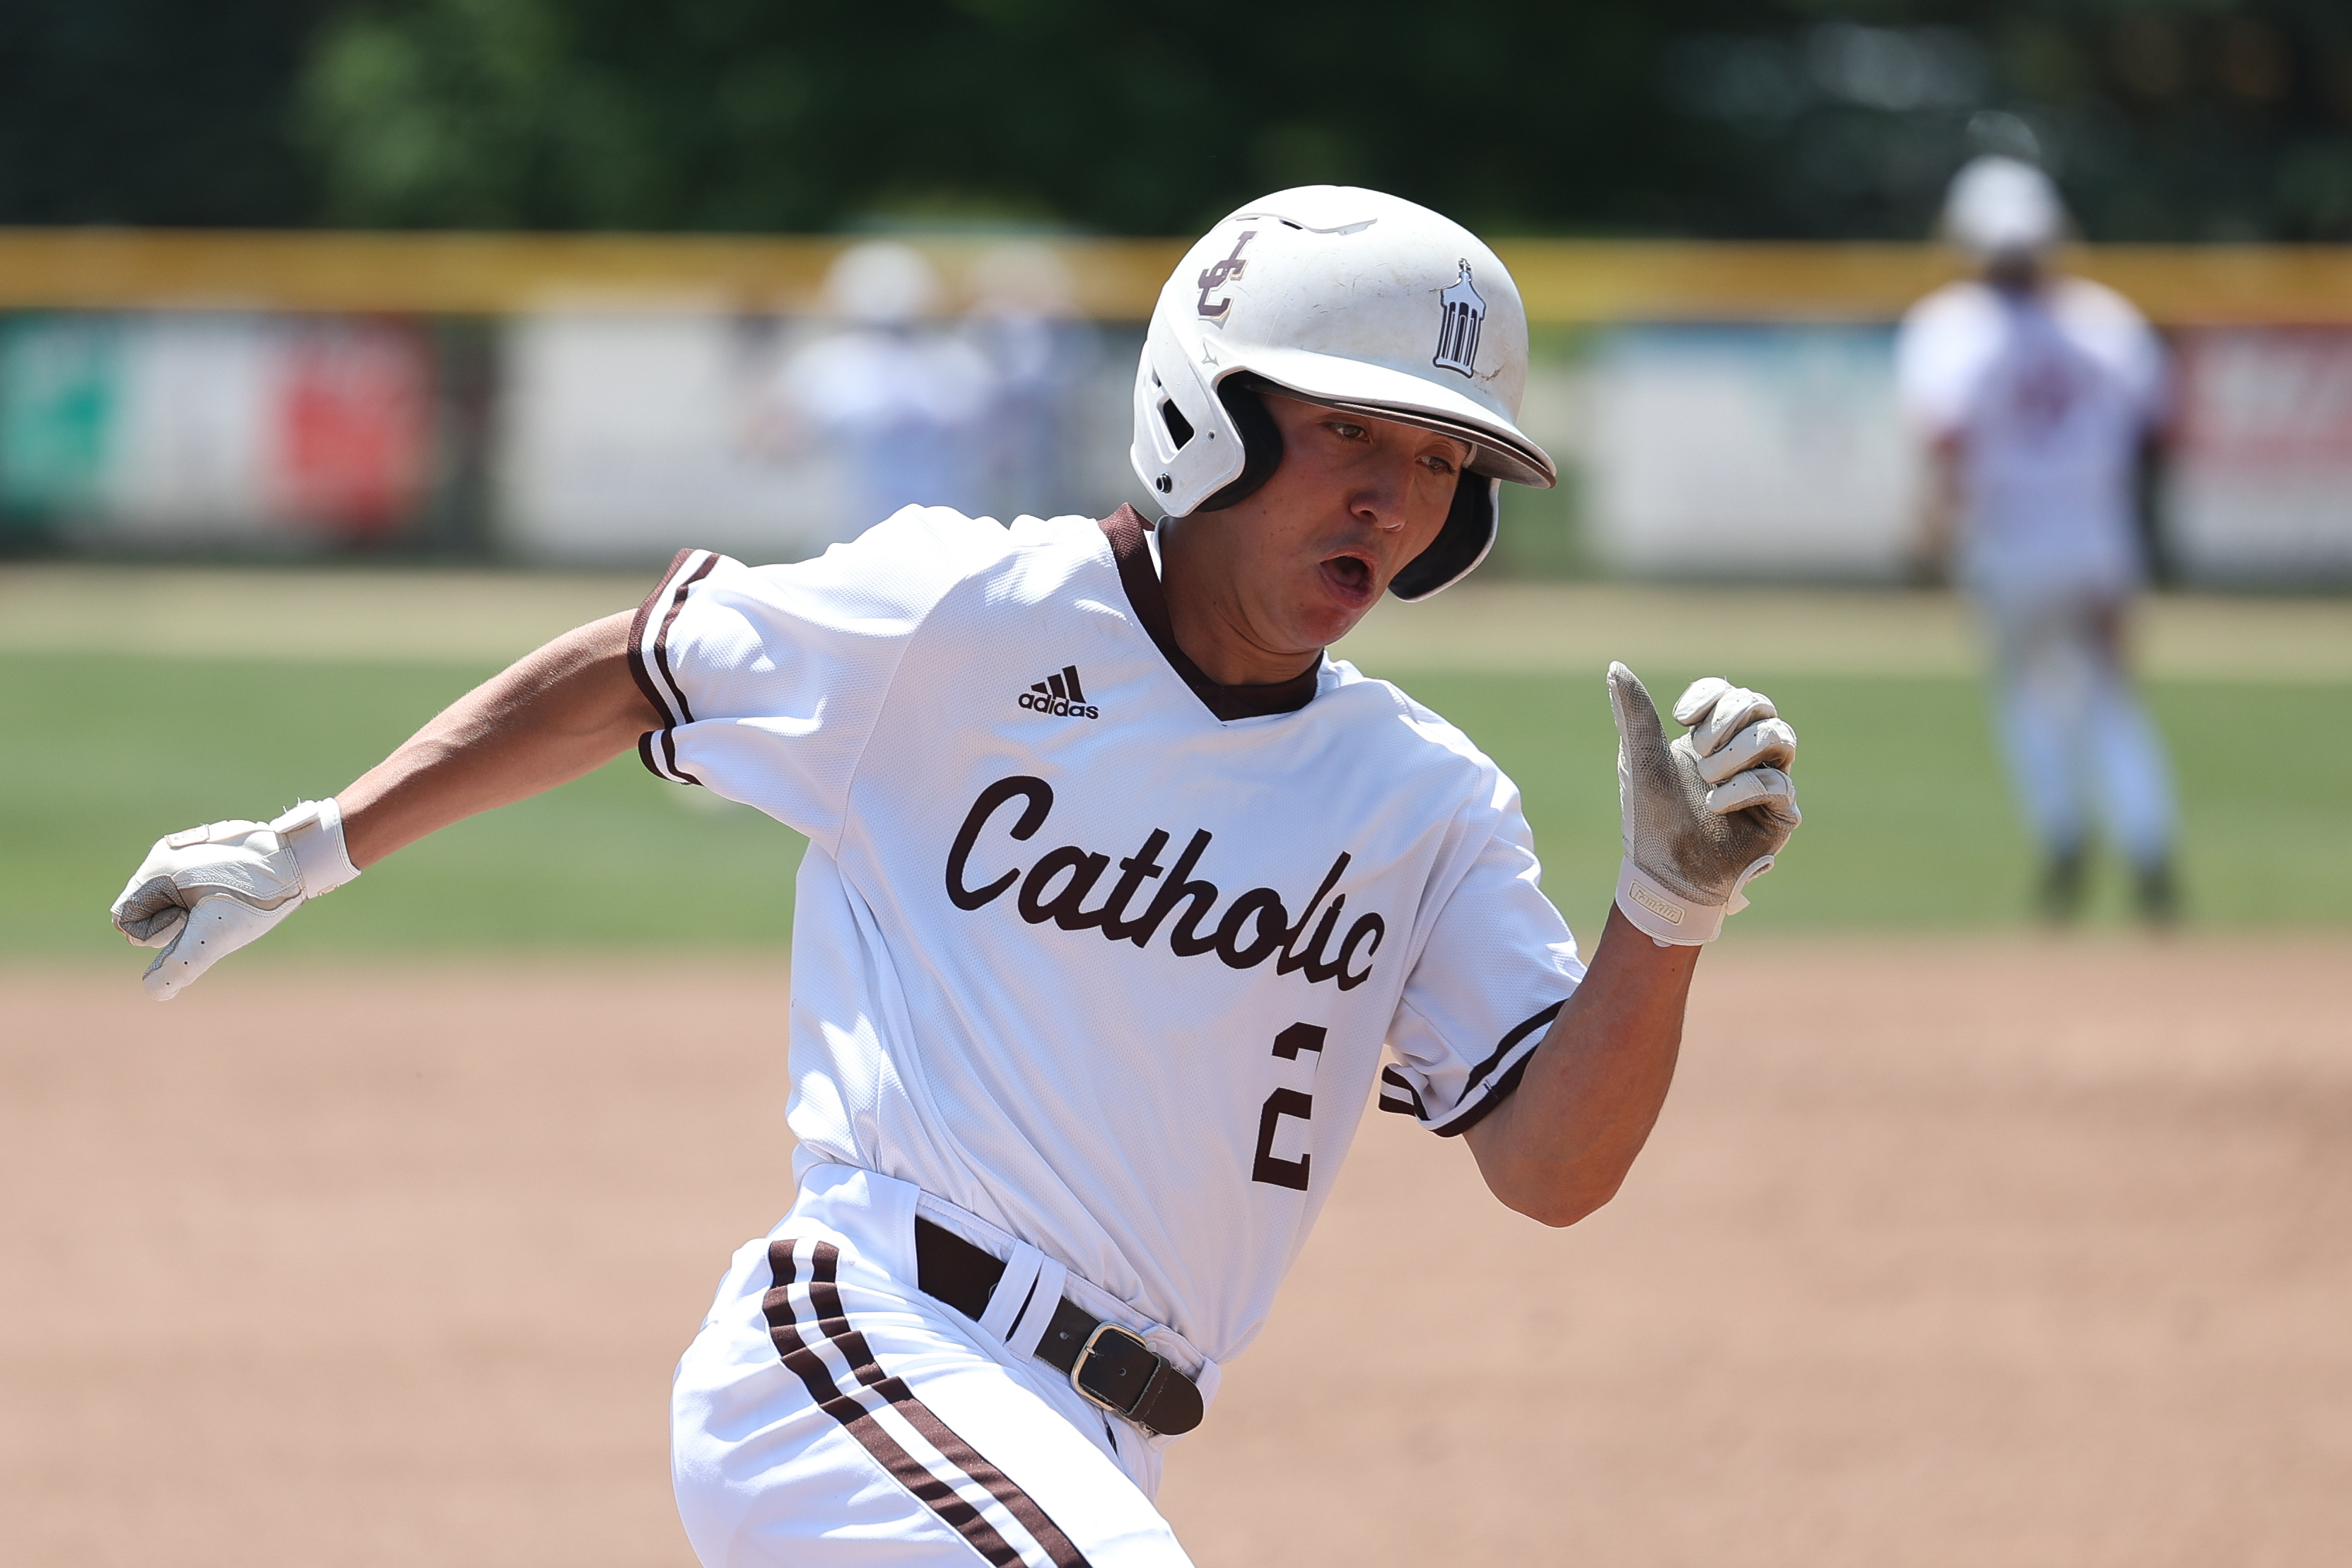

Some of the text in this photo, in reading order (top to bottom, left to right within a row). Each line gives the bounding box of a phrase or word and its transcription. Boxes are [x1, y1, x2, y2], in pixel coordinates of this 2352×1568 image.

[1018, 693, 1099, 719] adidas
[946, 776, 1385, 991] Catholic
[1252, 1022, 1328, 1191] 2
